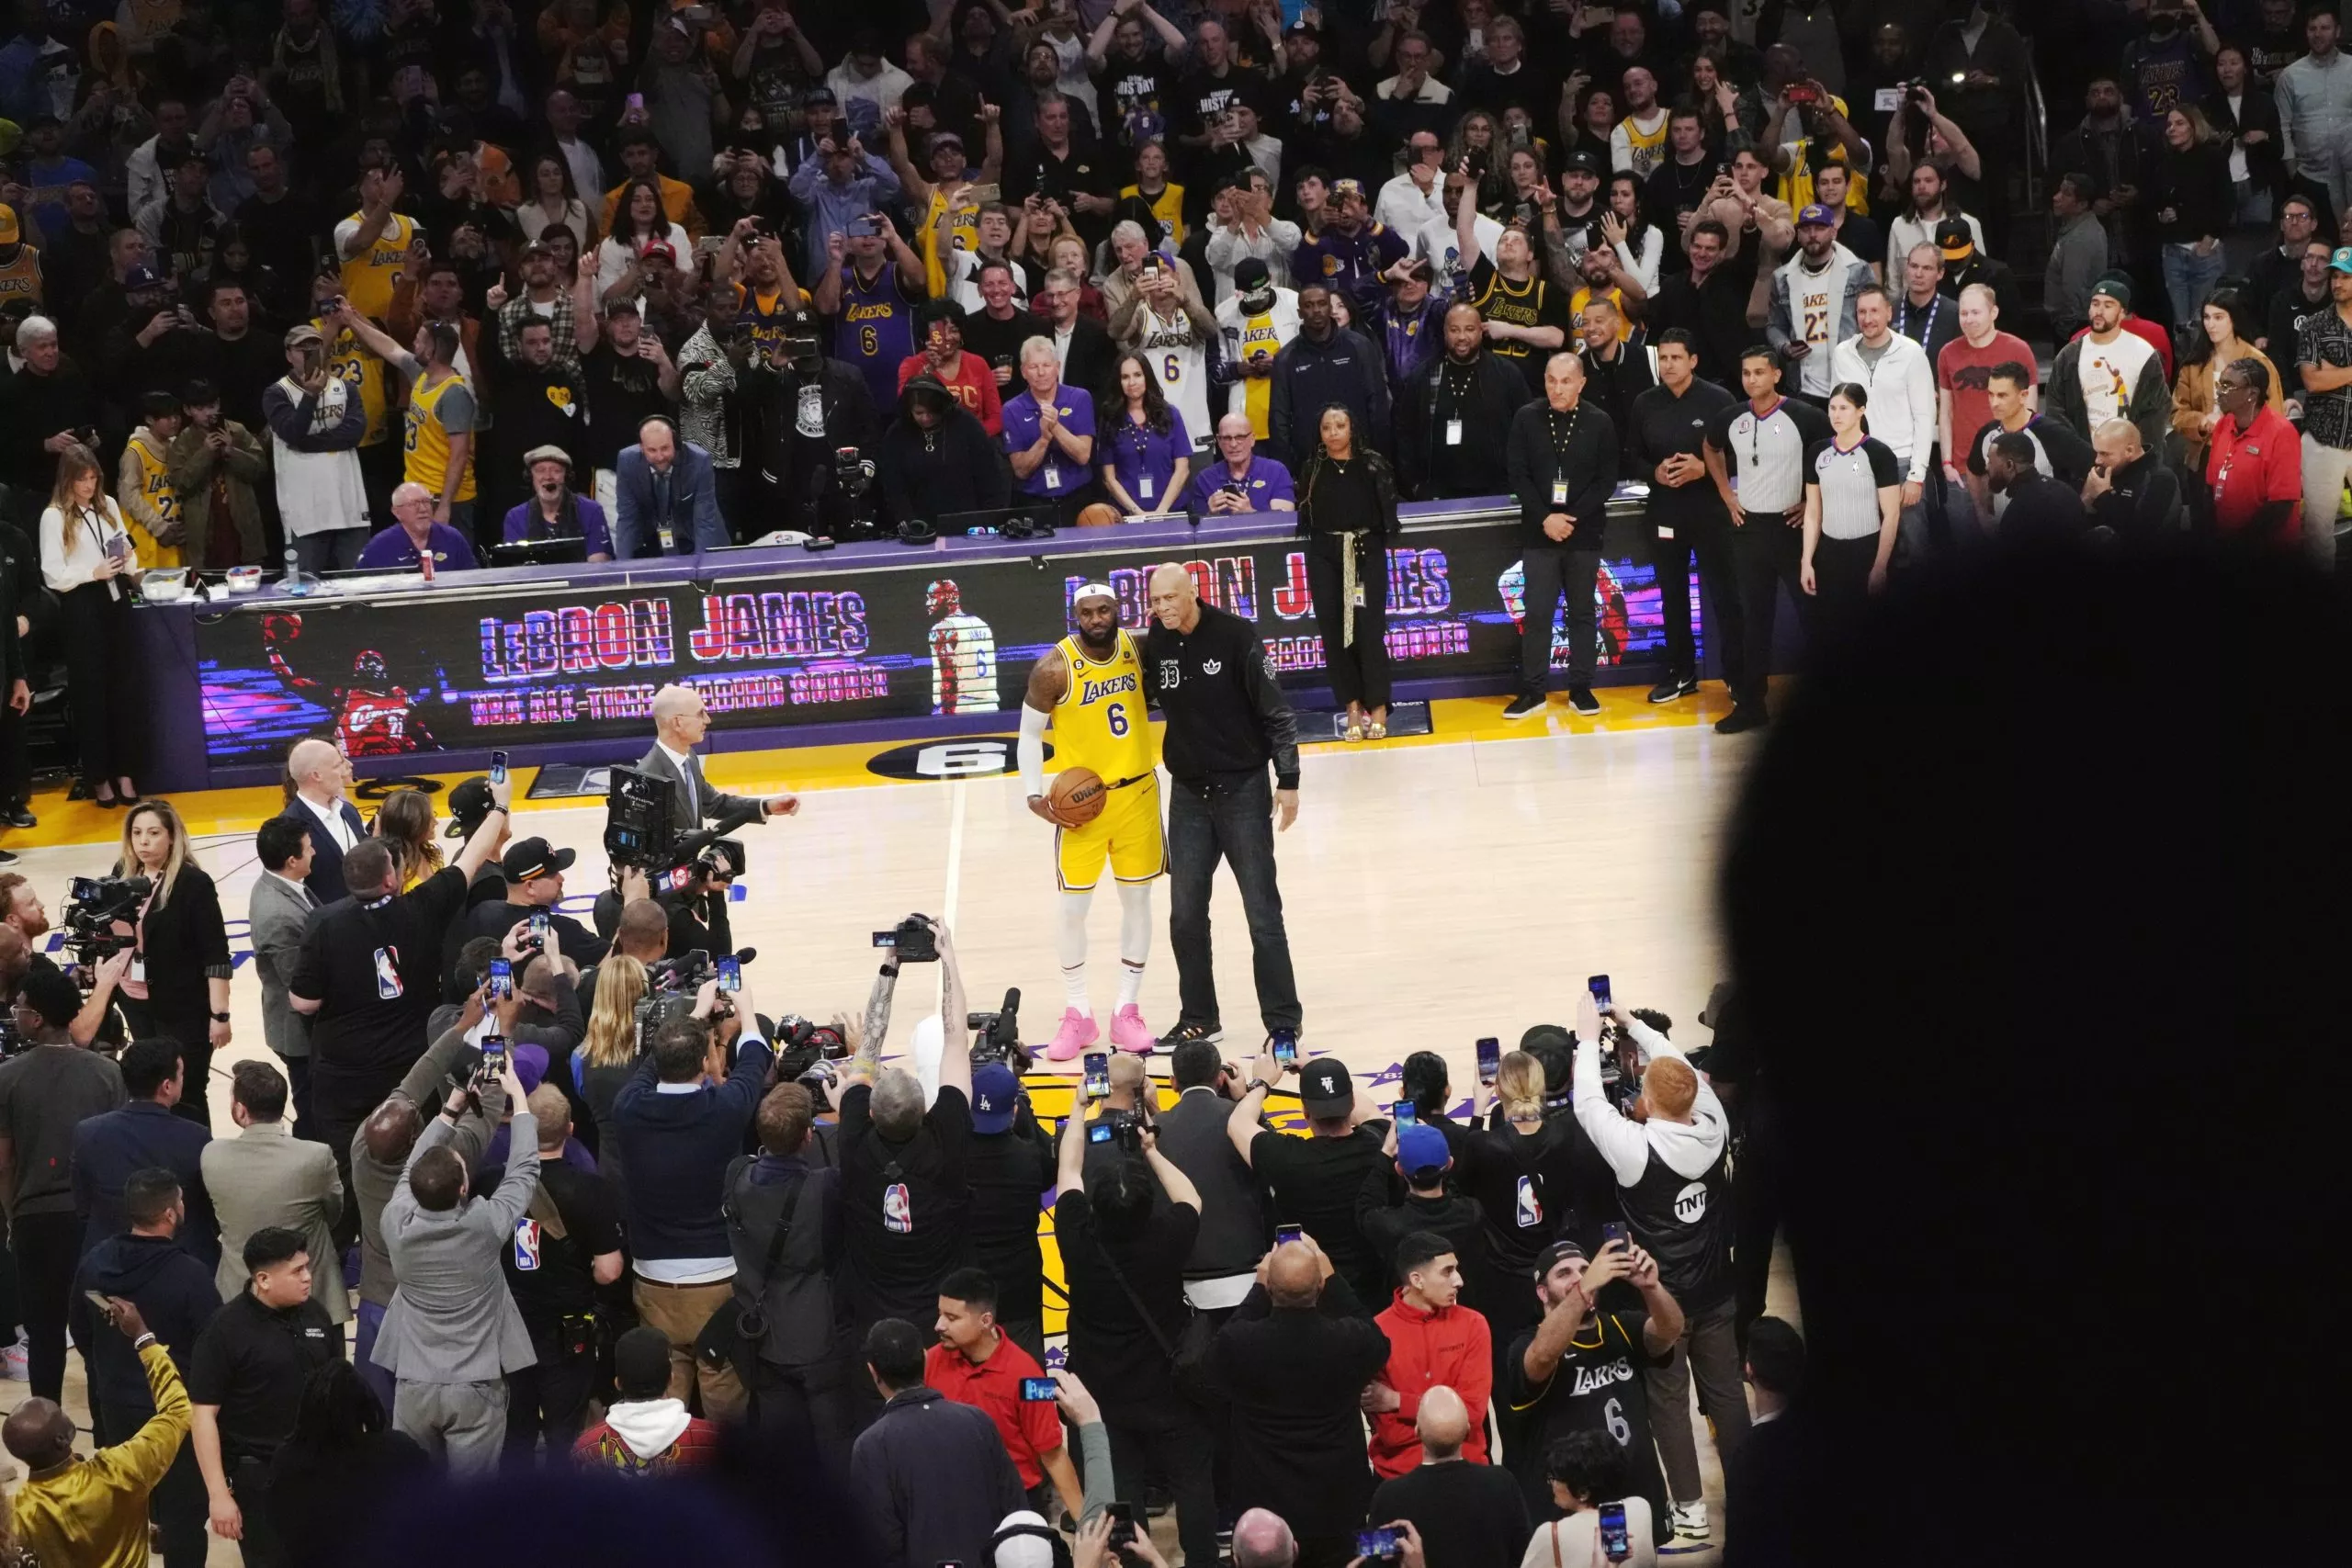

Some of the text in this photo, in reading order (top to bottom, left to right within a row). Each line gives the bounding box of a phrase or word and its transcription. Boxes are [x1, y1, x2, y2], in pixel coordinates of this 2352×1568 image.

[1200, 96, 1229, 113] HIST
[1632, 144, 1665, 163] LAKER
[370, 249, 406, 266] LAKE
[845, 302, 893, 322] LAKERS
[1486, 297, 1538, 326] LAKERS
[751, 322, 786, 341] AKERS
[860, 325, 878, 355] 6
[1146, 331, 1193, 349] LAKERS
[1243, 328, 1278, 344] AKER
[1164, 354, 1181, 381] 6
[689, 591, 870, 663] JAMES
[977, 649, 988, 678] 6
[1075, 659, 1083, 669] 6
[1159, 666, 1181, 690] 33
[470, 692, 526, 726] NBA
[790, 664, 889, 705] SCORER
[1079, 672, 1138, 706] LAKERS
[1107, 701, 1130, 739] 6
[916, 740, 1008, 776] 6
[1071, 783, 1104, 803] Wilson
[659, 876, 671, 892] NBA
[383, 987, 396, 996] NBA
[979, 1094, 990, 1111] LA
[1674, 1190, 1707, 1216] TNT
[888, 1220, 902, 1231] NBA
[1521, 1213, 1533, 1224] NBA
[519, 1256, 531, 1268] NBA
[1604, 1397, 1632, 1447] 6
